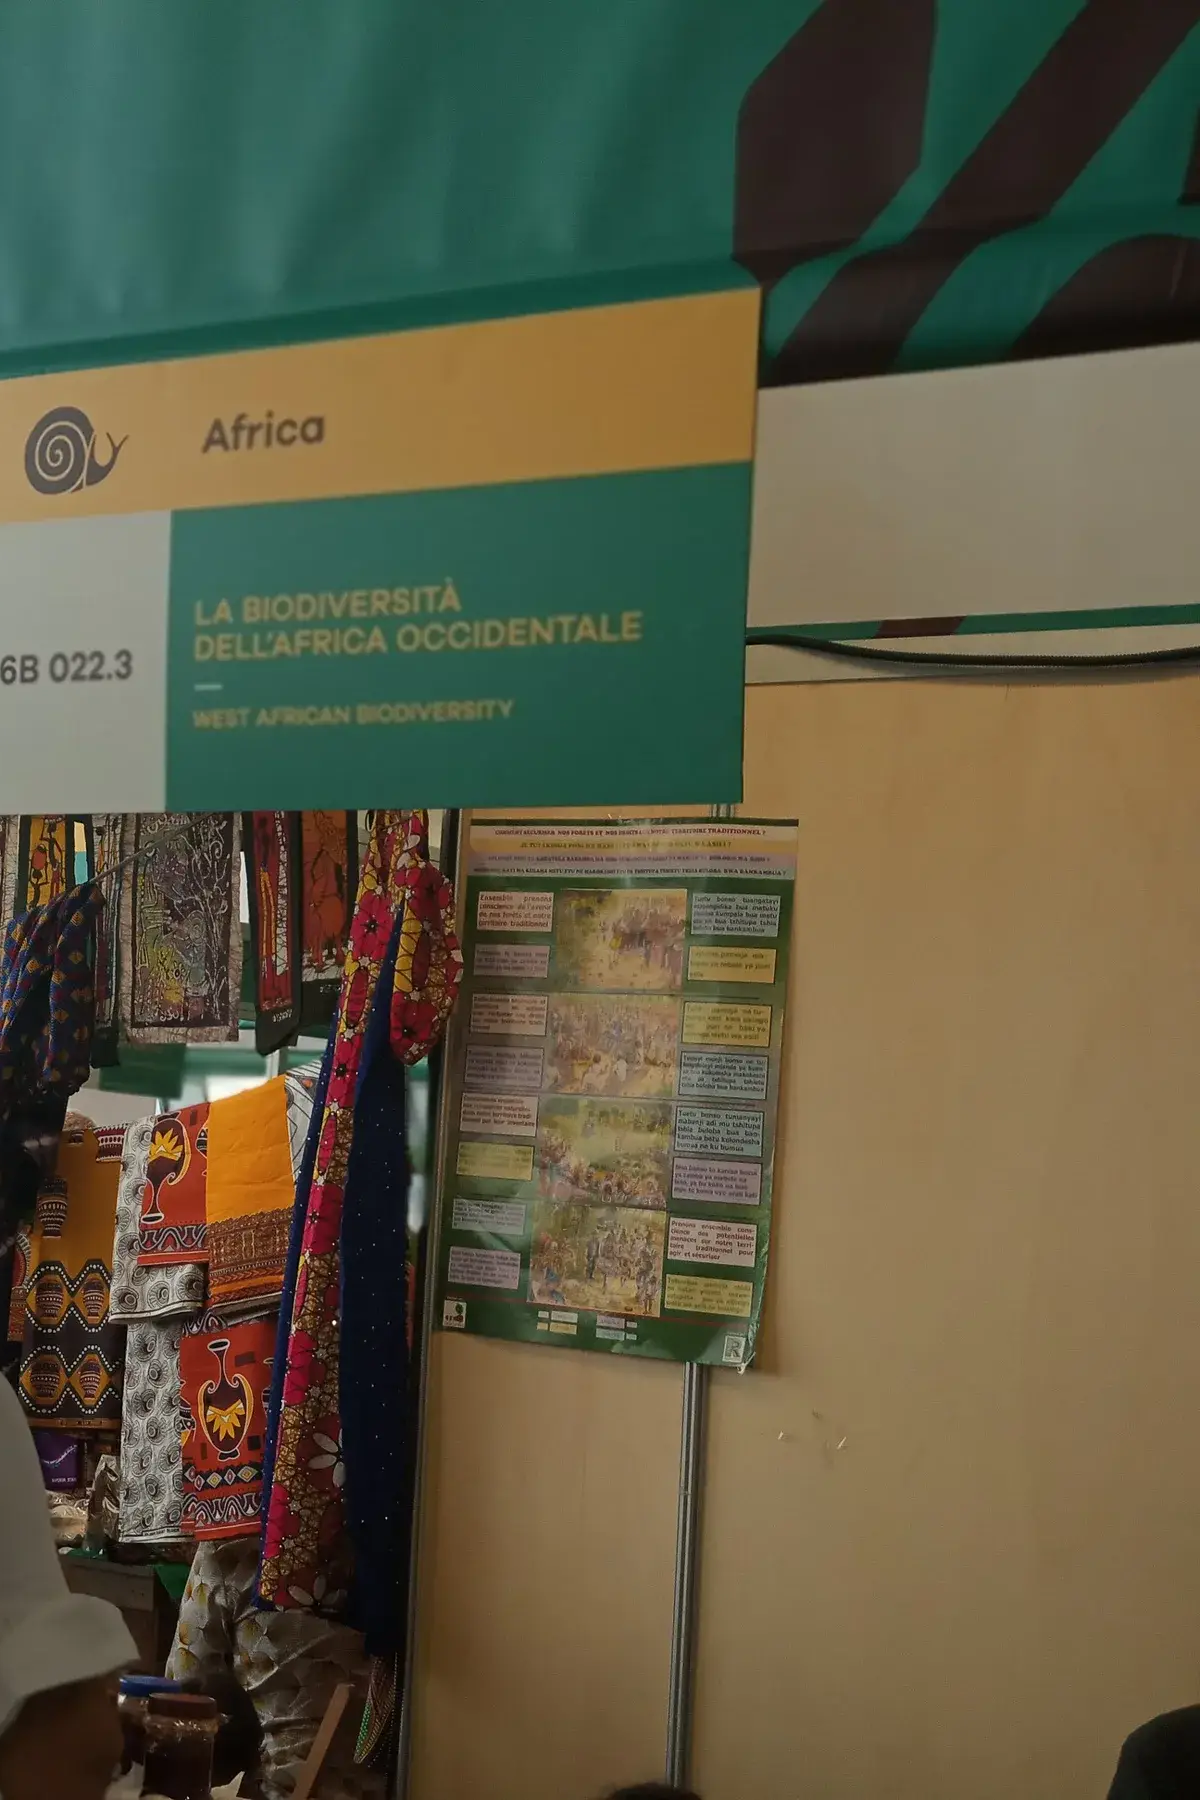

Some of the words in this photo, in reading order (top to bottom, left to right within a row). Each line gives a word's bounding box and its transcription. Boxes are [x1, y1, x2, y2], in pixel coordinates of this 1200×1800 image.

[202, 413, 326, 455] Africa
[195, 600, 233, 627] LA
[242, 577, 461, 624] BIODIVERSITÀ
[194, 627, 386, 661] DELL'AFRICA
[397, 611, 643, 654] OCCIDENTALE
[0, 654, 39, 686] 6B
[49, 650, 133, 685] 022.3
[193, 708, 249, 729] WEST
[256, 704, 351, 727] AFRICAN
[357, 699, 514, 725] BIODIVERSITY
